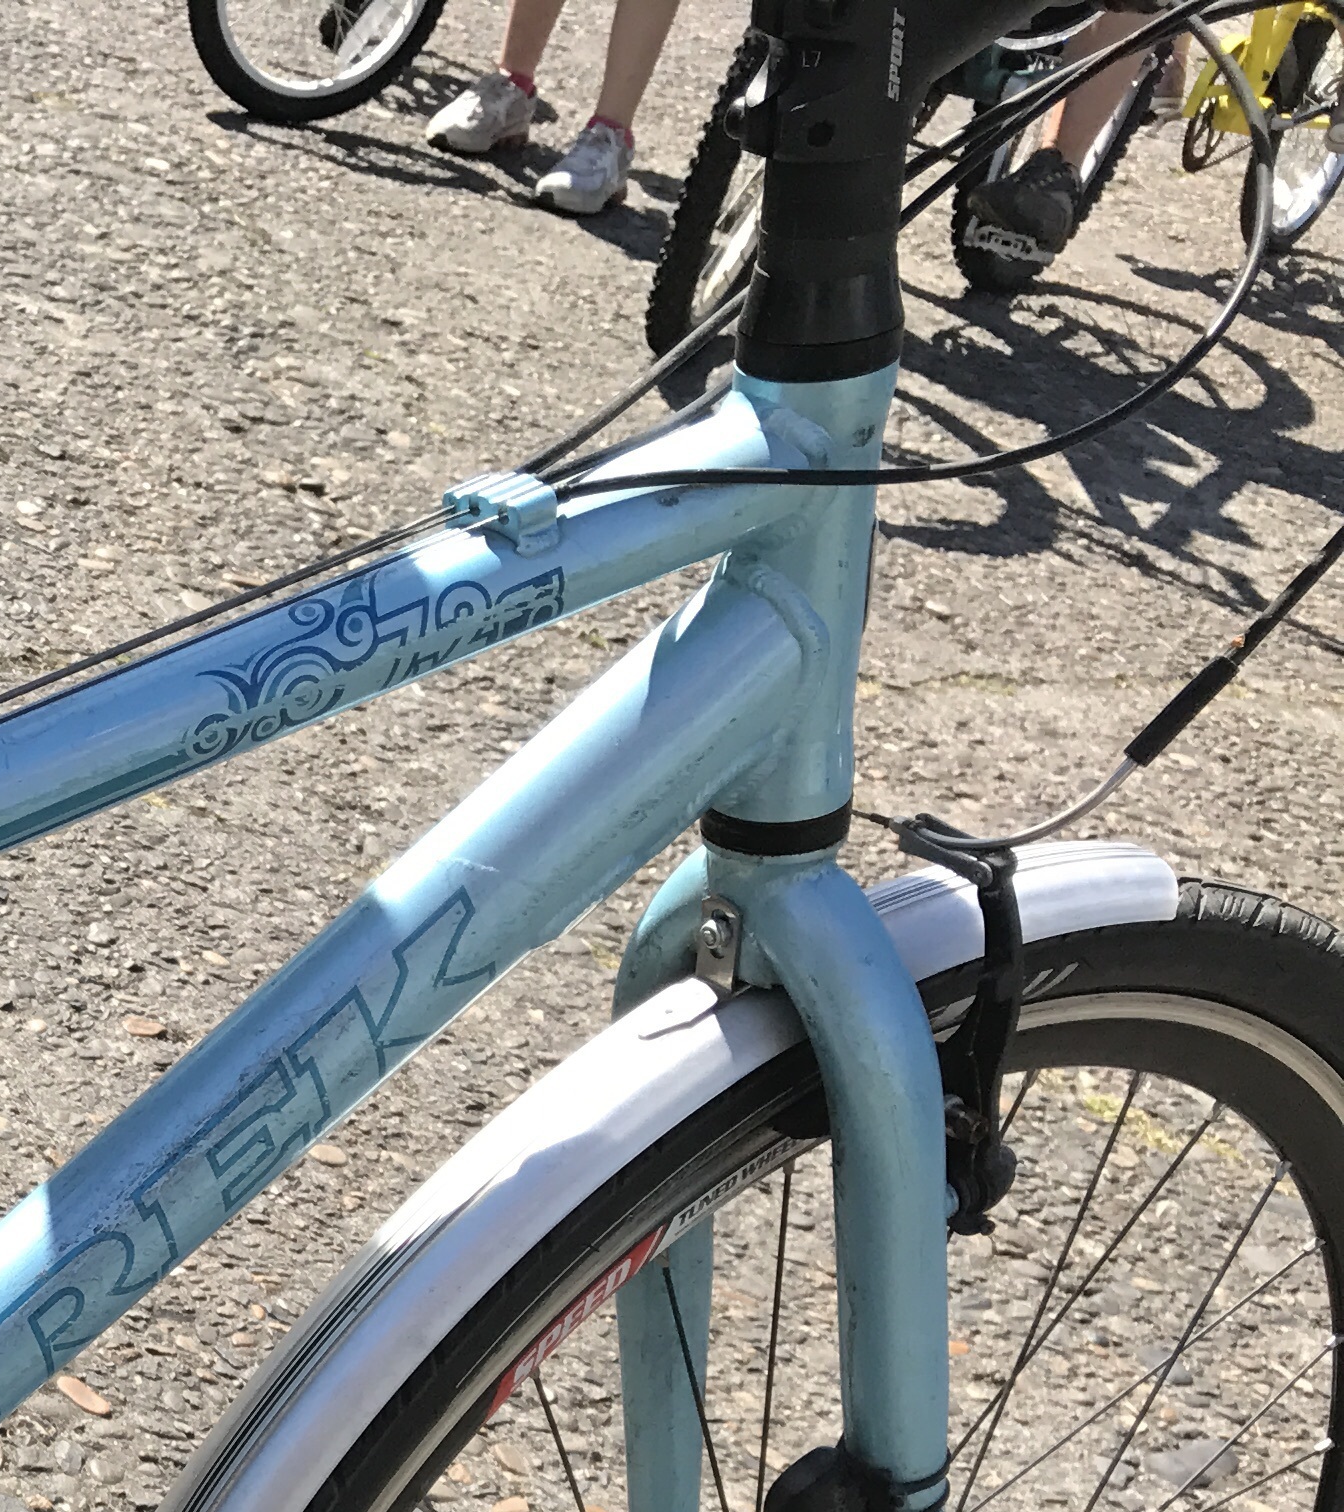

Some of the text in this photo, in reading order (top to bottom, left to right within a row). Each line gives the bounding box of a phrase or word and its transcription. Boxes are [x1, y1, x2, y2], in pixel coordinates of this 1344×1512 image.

[887, 6, 907, 103] SPORT
[513, 1138, 799, 1385] SPEED TUNED WHEEL
